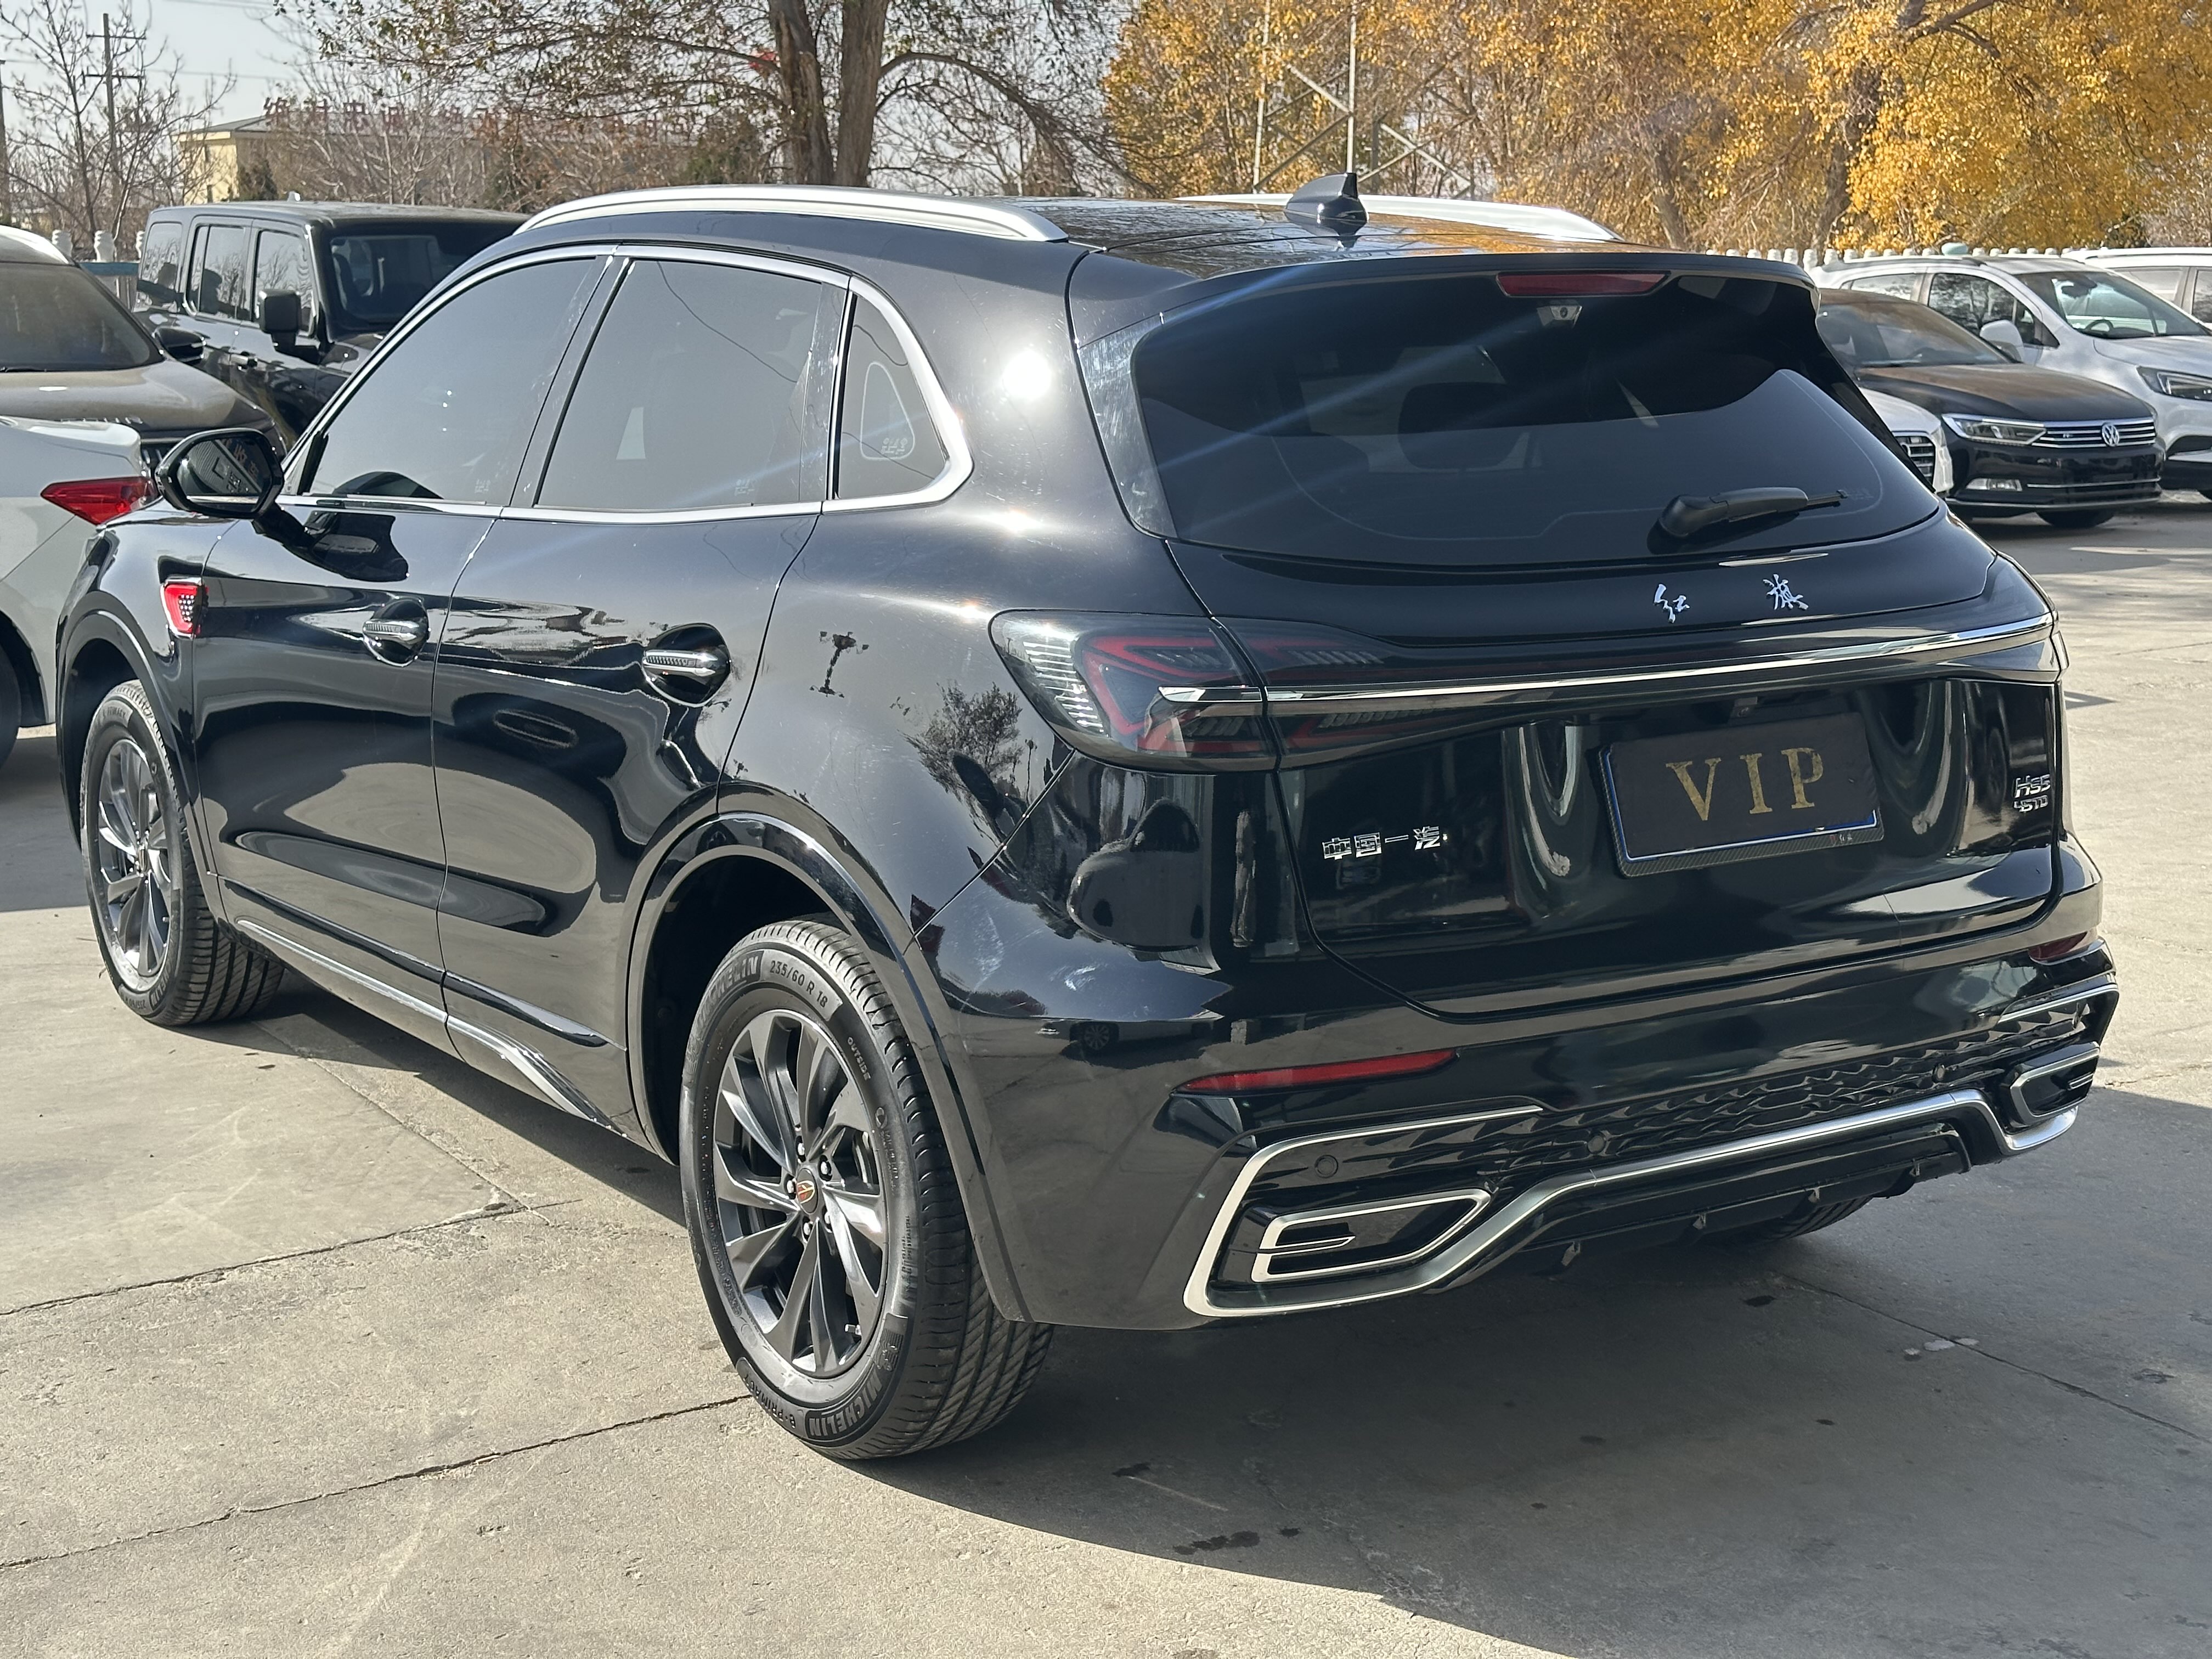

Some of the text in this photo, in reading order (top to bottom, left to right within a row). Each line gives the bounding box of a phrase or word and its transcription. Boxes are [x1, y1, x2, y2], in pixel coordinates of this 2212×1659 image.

[1666, 747, 1824, 821] VIP
[2015, 774, 2051, 798] HS5
[1322, 825, 1441, 860] 中国一汽
[769, 960, 828, 1008] 235/60 R 18
[847, 1037, 871, 1081] OUTSIDE
[809, 1368, 883, 1437] MICHELIN
